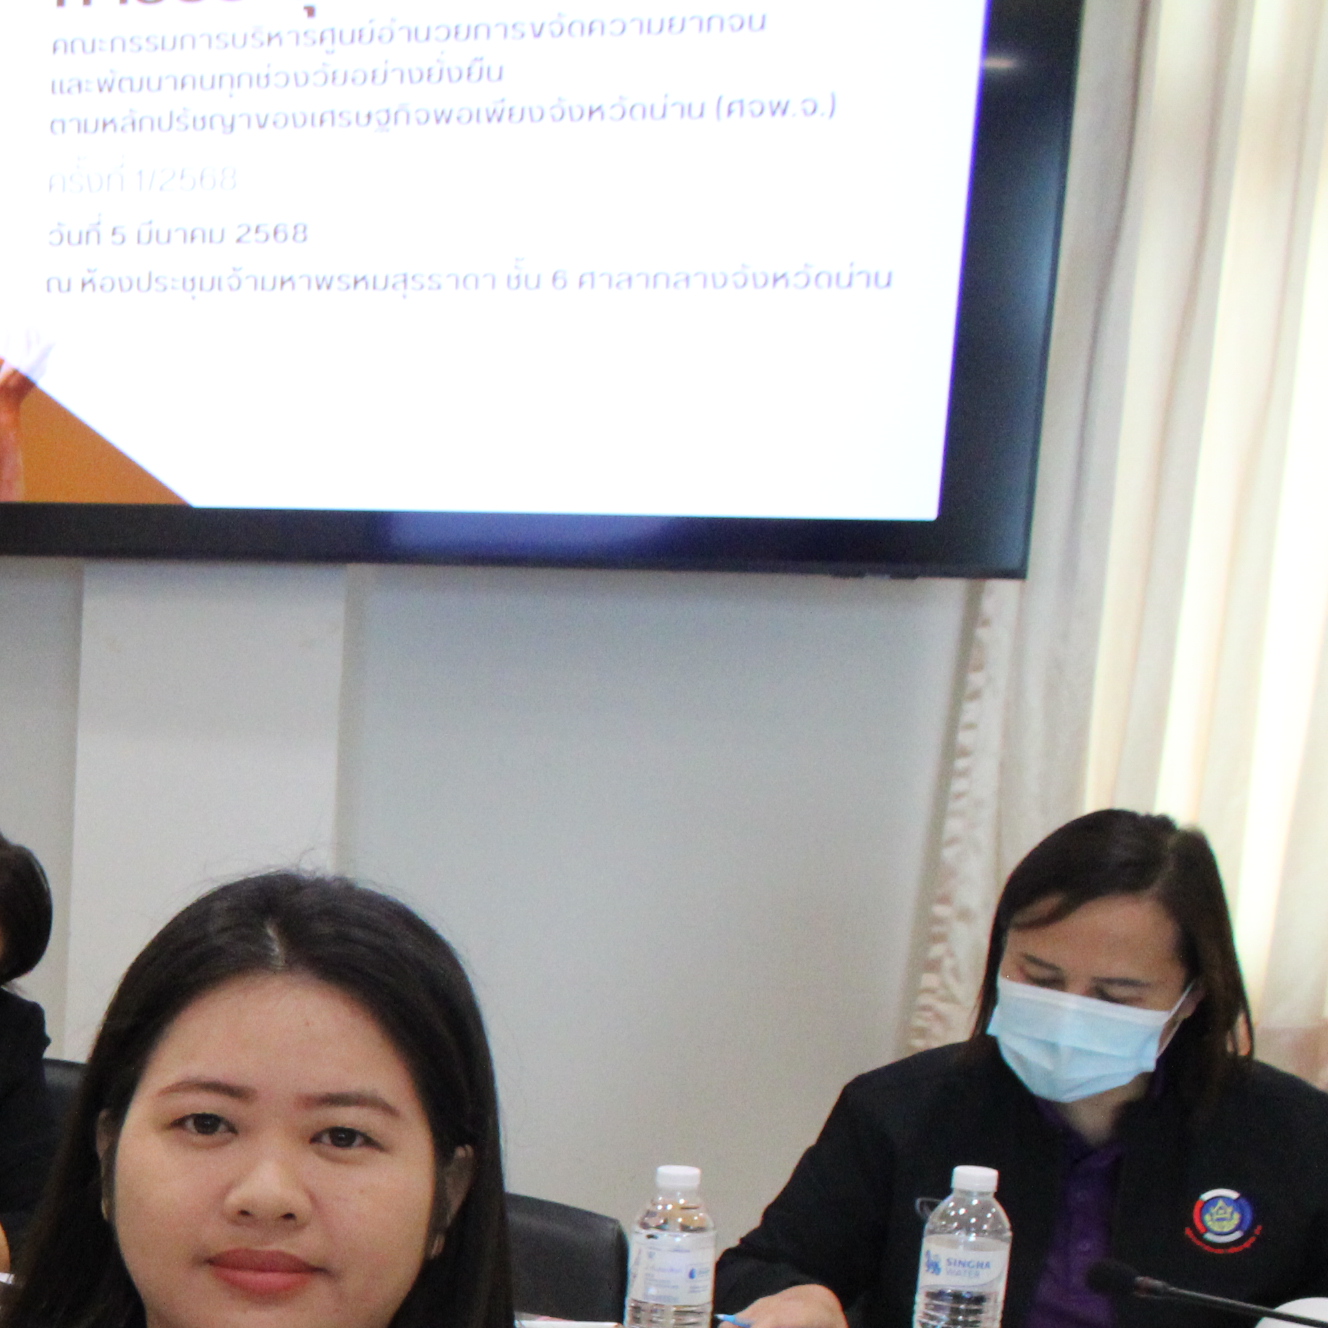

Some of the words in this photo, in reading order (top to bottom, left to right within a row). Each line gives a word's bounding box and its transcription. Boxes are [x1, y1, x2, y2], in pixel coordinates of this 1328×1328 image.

[52, 11, 768, 55] คณะกรรมการบริหารศูนย์อำนวยการขจัดความยากจน
[50, 50, 504, 98] และพัฒนาคนทุกช่วงวัยอย่างยั่งยืน
[49, 96, 706, 135] ตามหลักปรัชญาของเศรษฐกิจพอเพียงจังหวัดน่าน
[715, 91, 837, 122] (ศจพ.จ.)
[48, 212, 102, 247] วันที่
[111, 225, 126, 246] 5
[137, 219, 225, 246] มีนาคม
[236, 222, 309, 245] 2568
[46, 275, 72, 294] ณ
[506, 257, 542, 291] ชั้น
[551, 269, 568, 291] 6
[578, 261, 893, 291] ศาลากลางจังหวัดน่าน
[946, 1258, 992, 1270] SINGHA
